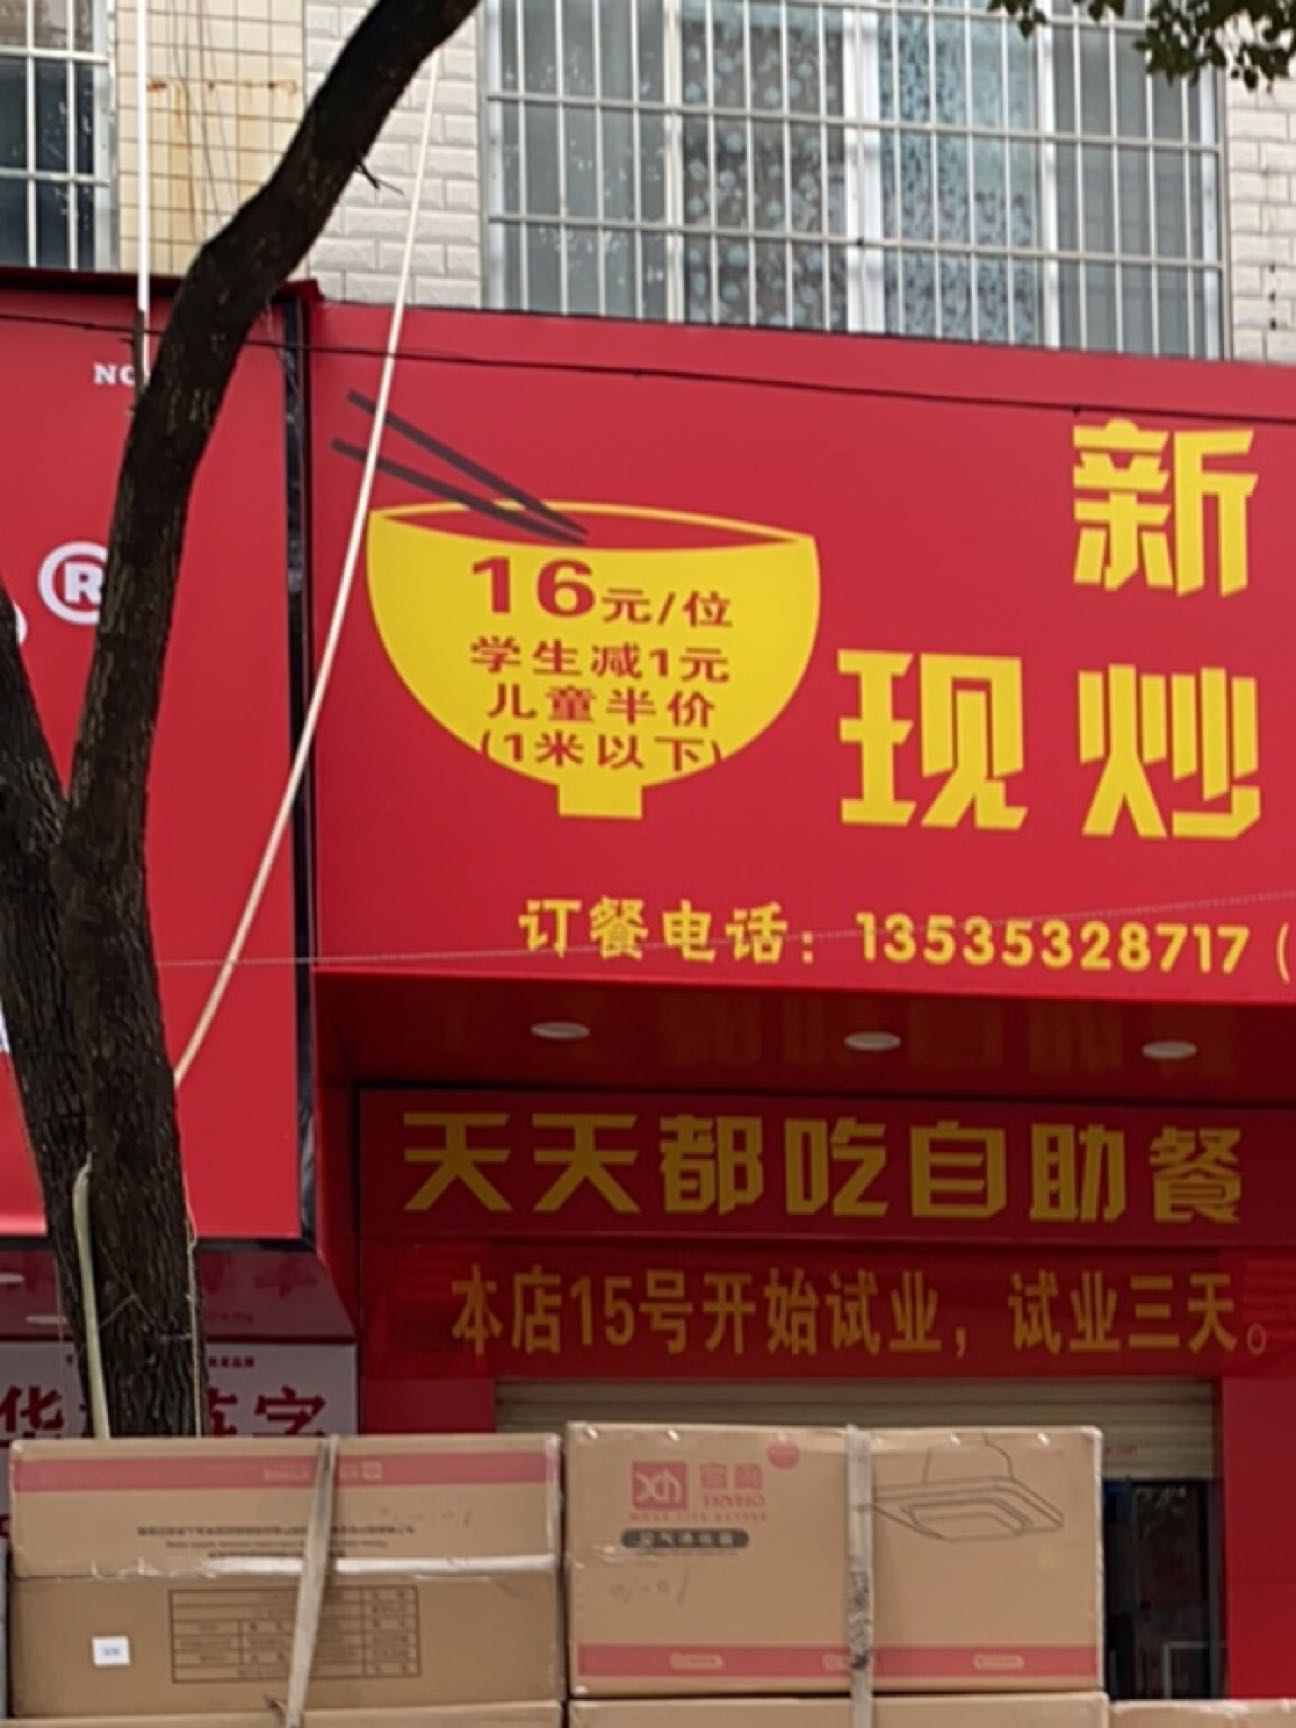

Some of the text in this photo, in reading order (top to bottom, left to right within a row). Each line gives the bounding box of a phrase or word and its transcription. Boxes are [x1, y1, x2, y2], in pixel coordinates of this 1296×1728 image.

[471, 555, 734, 629] 16元/位
[470, 635, 730, 684] 学生减1元
[487, 682, 716, 729] 儿童半价
[403, 1112, 1243, 1224] 天天都吃自助餐
